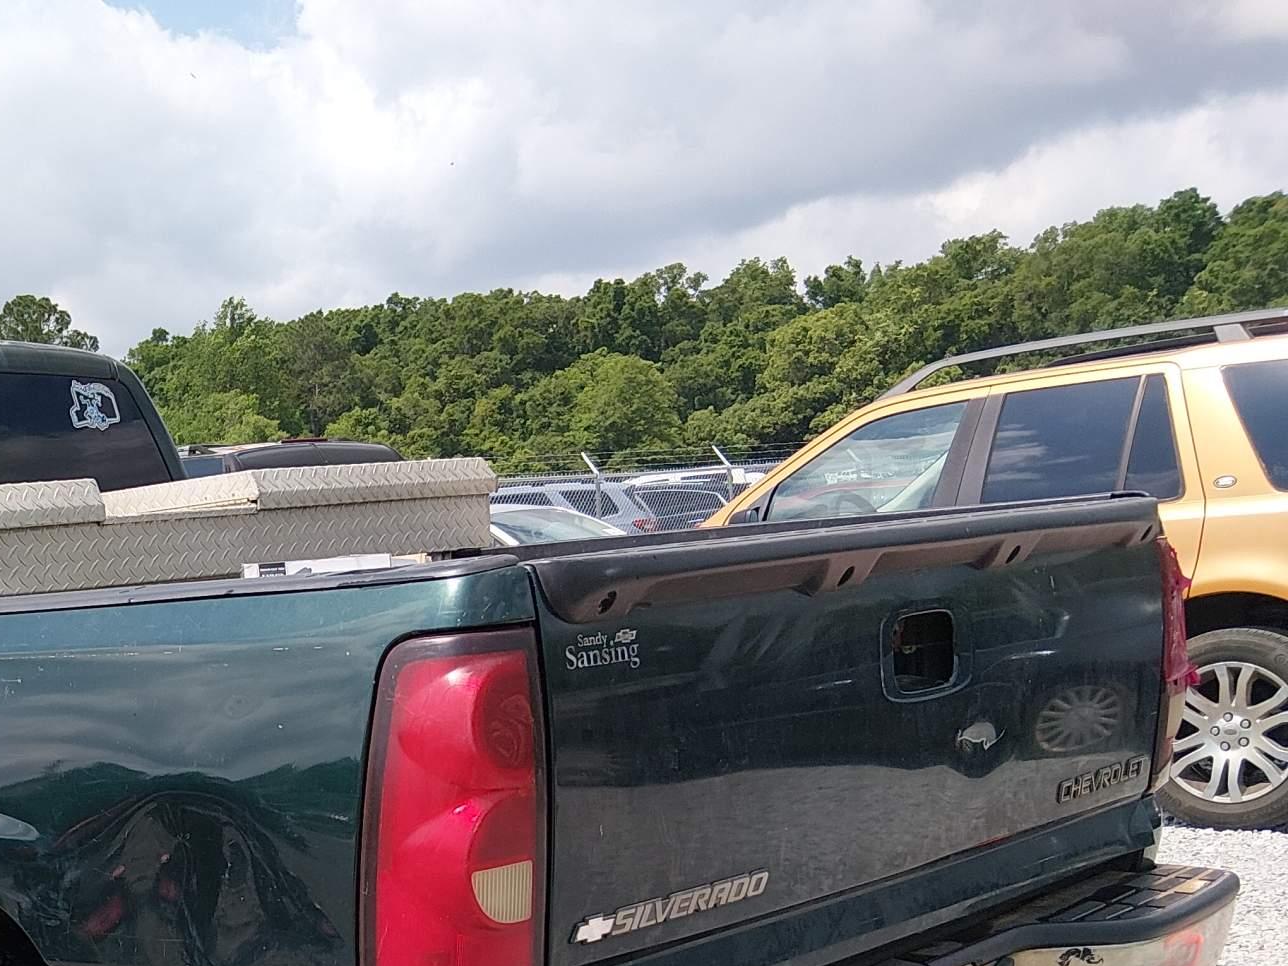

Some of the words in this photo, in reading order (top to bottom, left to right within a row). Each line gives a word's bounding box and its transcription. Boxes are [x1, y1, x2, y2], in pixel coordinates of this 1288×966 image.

[565, 643, 641, 670] Sansing
[577, 631, 608, 648] Sandy
[1057, 754, 1149, 803] CHEVROLET
[611, 868, 769, 936] SILVERADO
